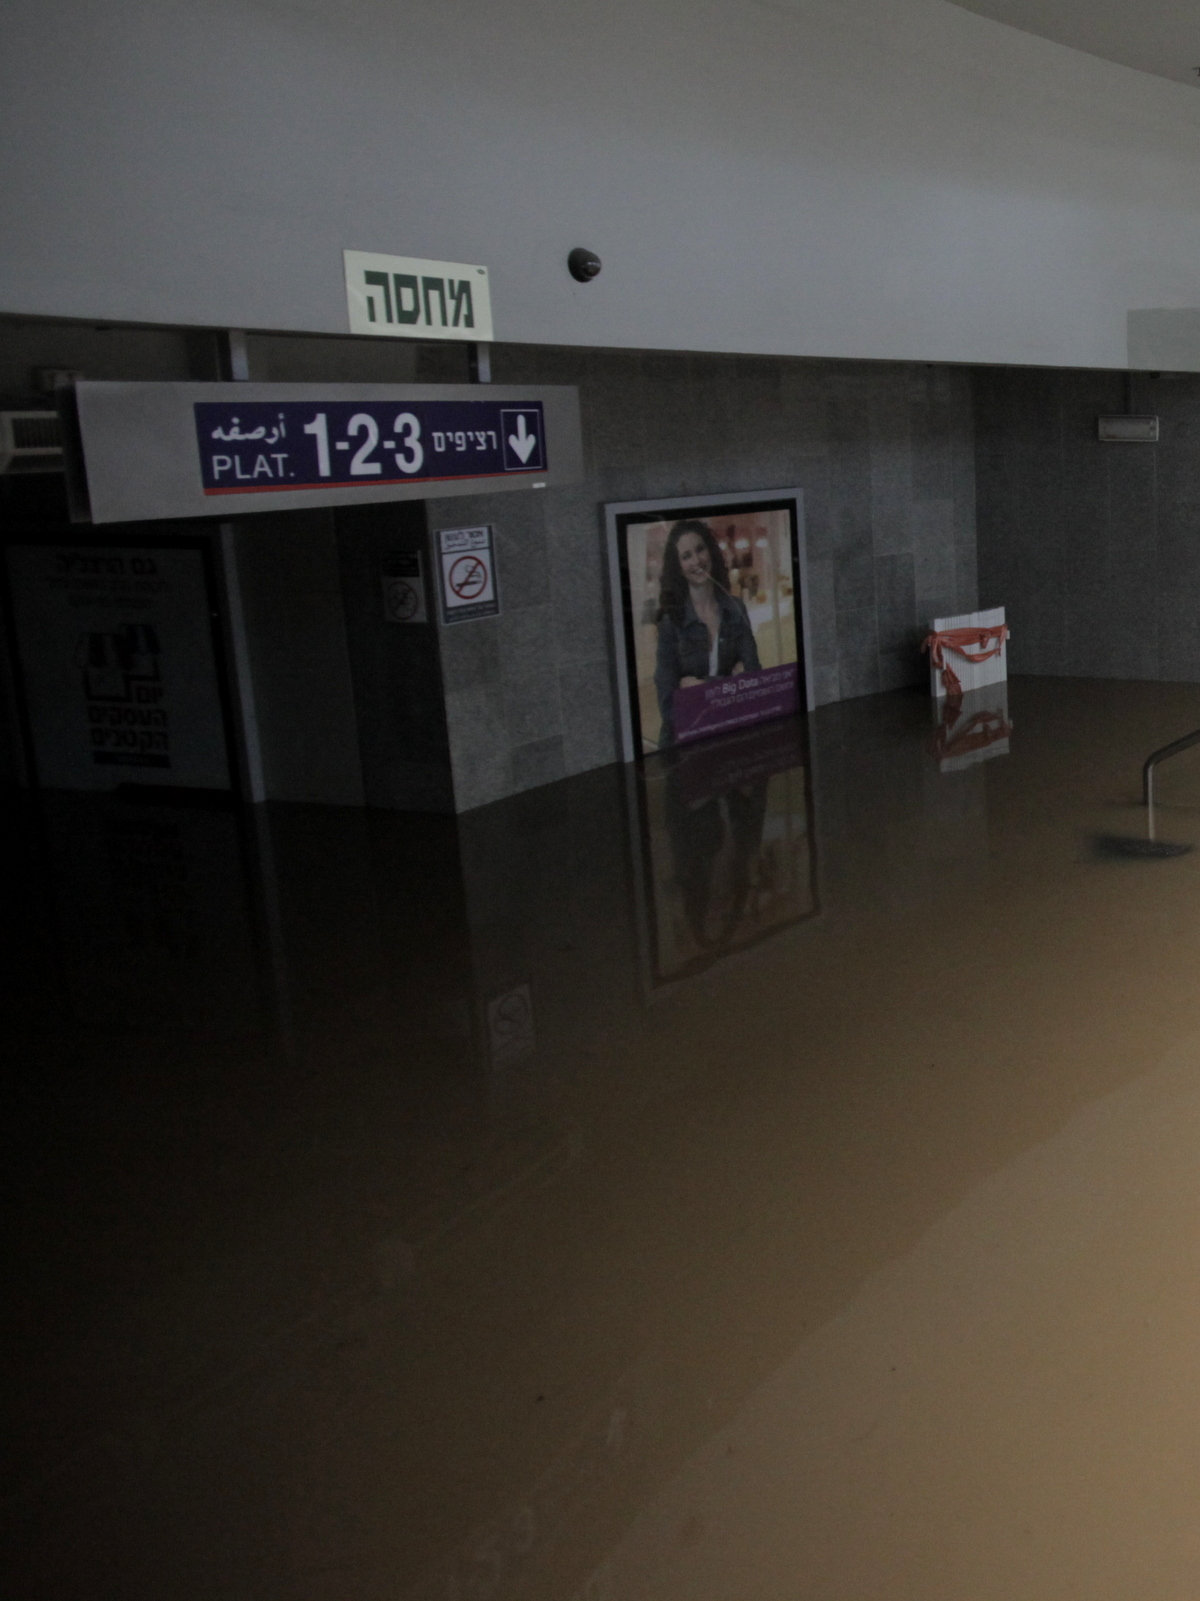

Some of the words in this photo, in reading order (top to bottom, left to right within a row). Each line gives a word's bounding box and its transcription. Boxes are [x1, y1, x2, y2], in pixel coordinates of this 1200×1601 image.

[364, 270, 475, 328] מחסה
[303, 411, 425, 478] 1-2-3
[432, 430, 498, 453] רציפים
[211, 453, 296, 480] PLAT.
[90, 728, 169, 753] הקטנים
